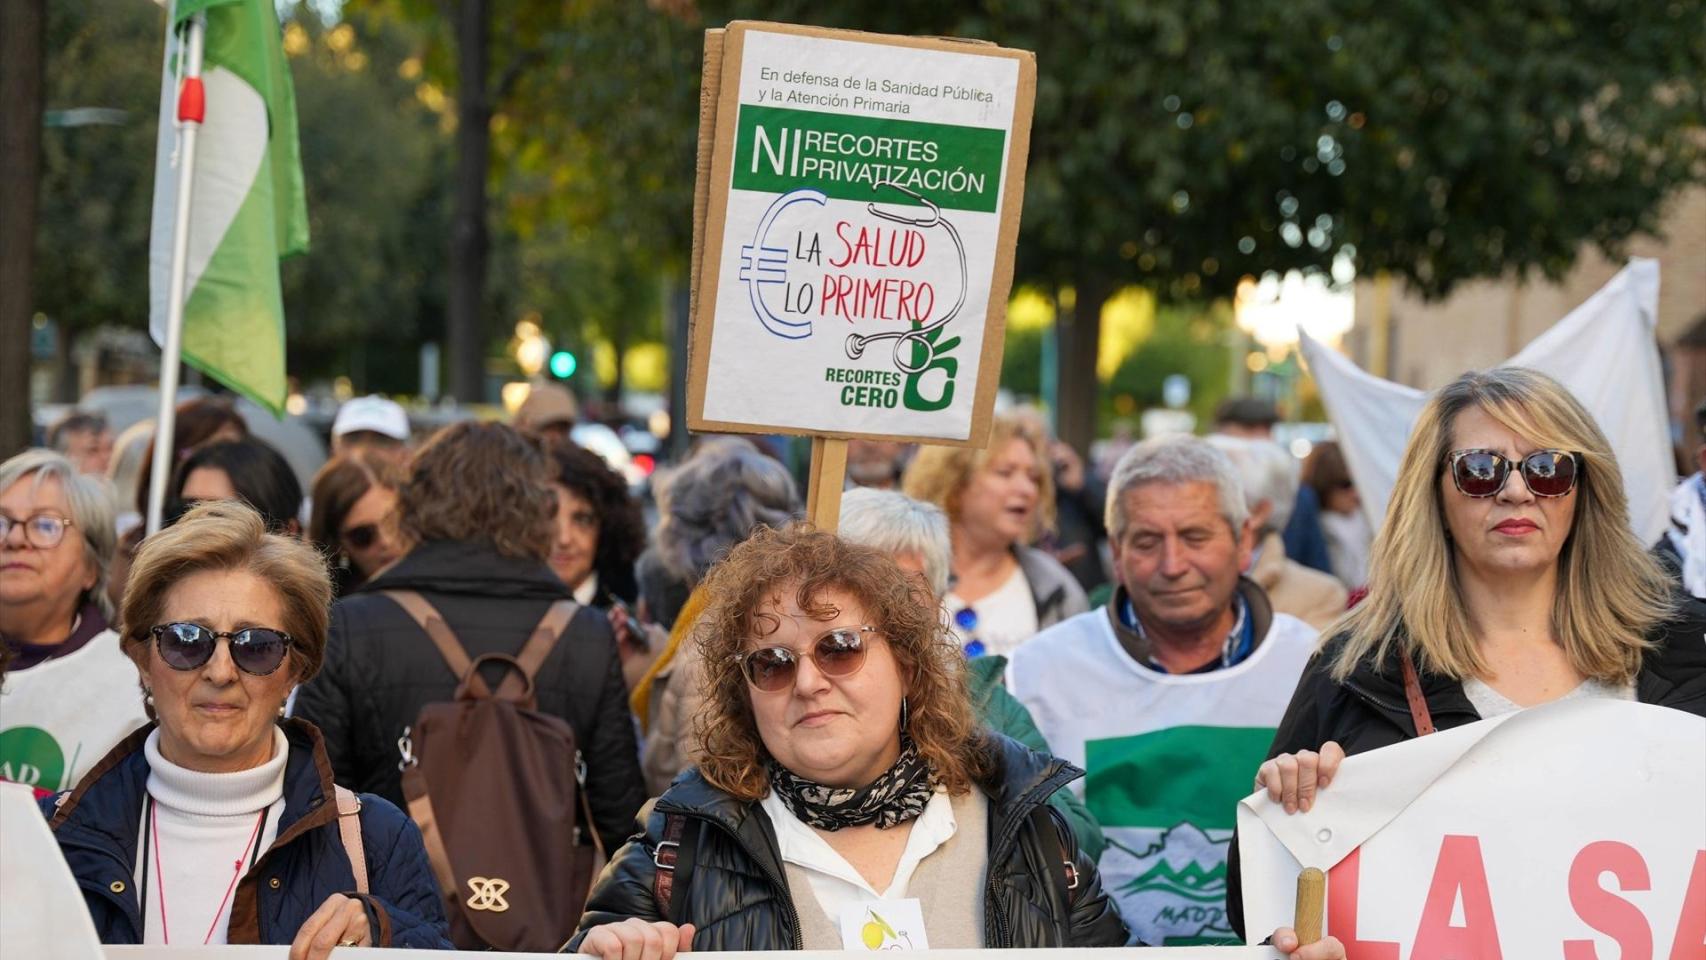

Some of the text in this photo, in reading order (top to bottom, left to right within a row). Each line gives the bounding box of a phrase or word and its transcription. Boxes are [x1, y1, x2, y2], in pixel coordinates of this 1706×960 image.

[758, 88, 910, 114] y la Atención Primaria
[761, 68, 994, 102] En defensa de la Sanidad Pública
[751, 125, 801, 177] NI
[804, 130, 938, 162] RECORTES
[801, 157, 985, 194] PRIVATIZACIÓN
[795, 221, 925, 267] LA SALUD
[784, 274, 934, 324] LO PRIMERO
[825, 367, 901, 386] RECORTES
[840, 386, 898, 408] CERO
[1327, 834, 1504, 960] LA
